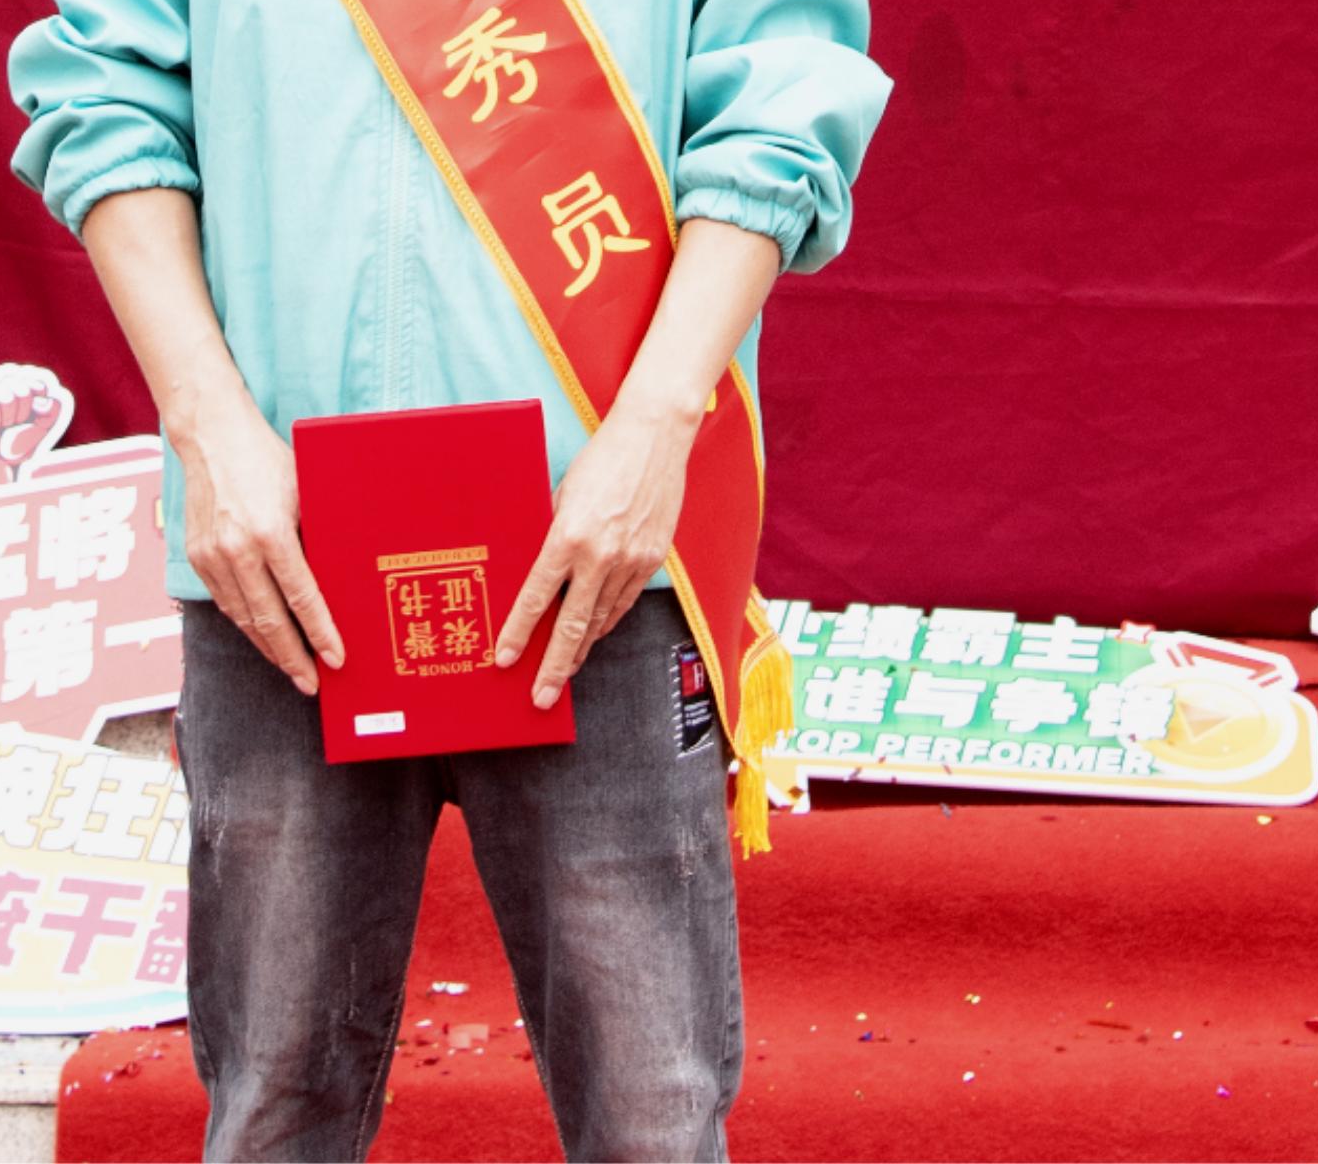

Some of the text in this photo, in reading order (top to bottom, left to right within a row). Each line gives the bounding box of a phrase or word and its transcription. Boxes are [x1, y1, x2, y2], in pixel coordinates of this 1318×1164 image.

[399, 577, 477, 618] 证书
[403, 617, 481, 659] 荣誉
[417, 660, 474, 677] HONOR
[802, 666, 1176, 741] 谁与争锋
[872, 733, 1154, 778] PERFORMER
